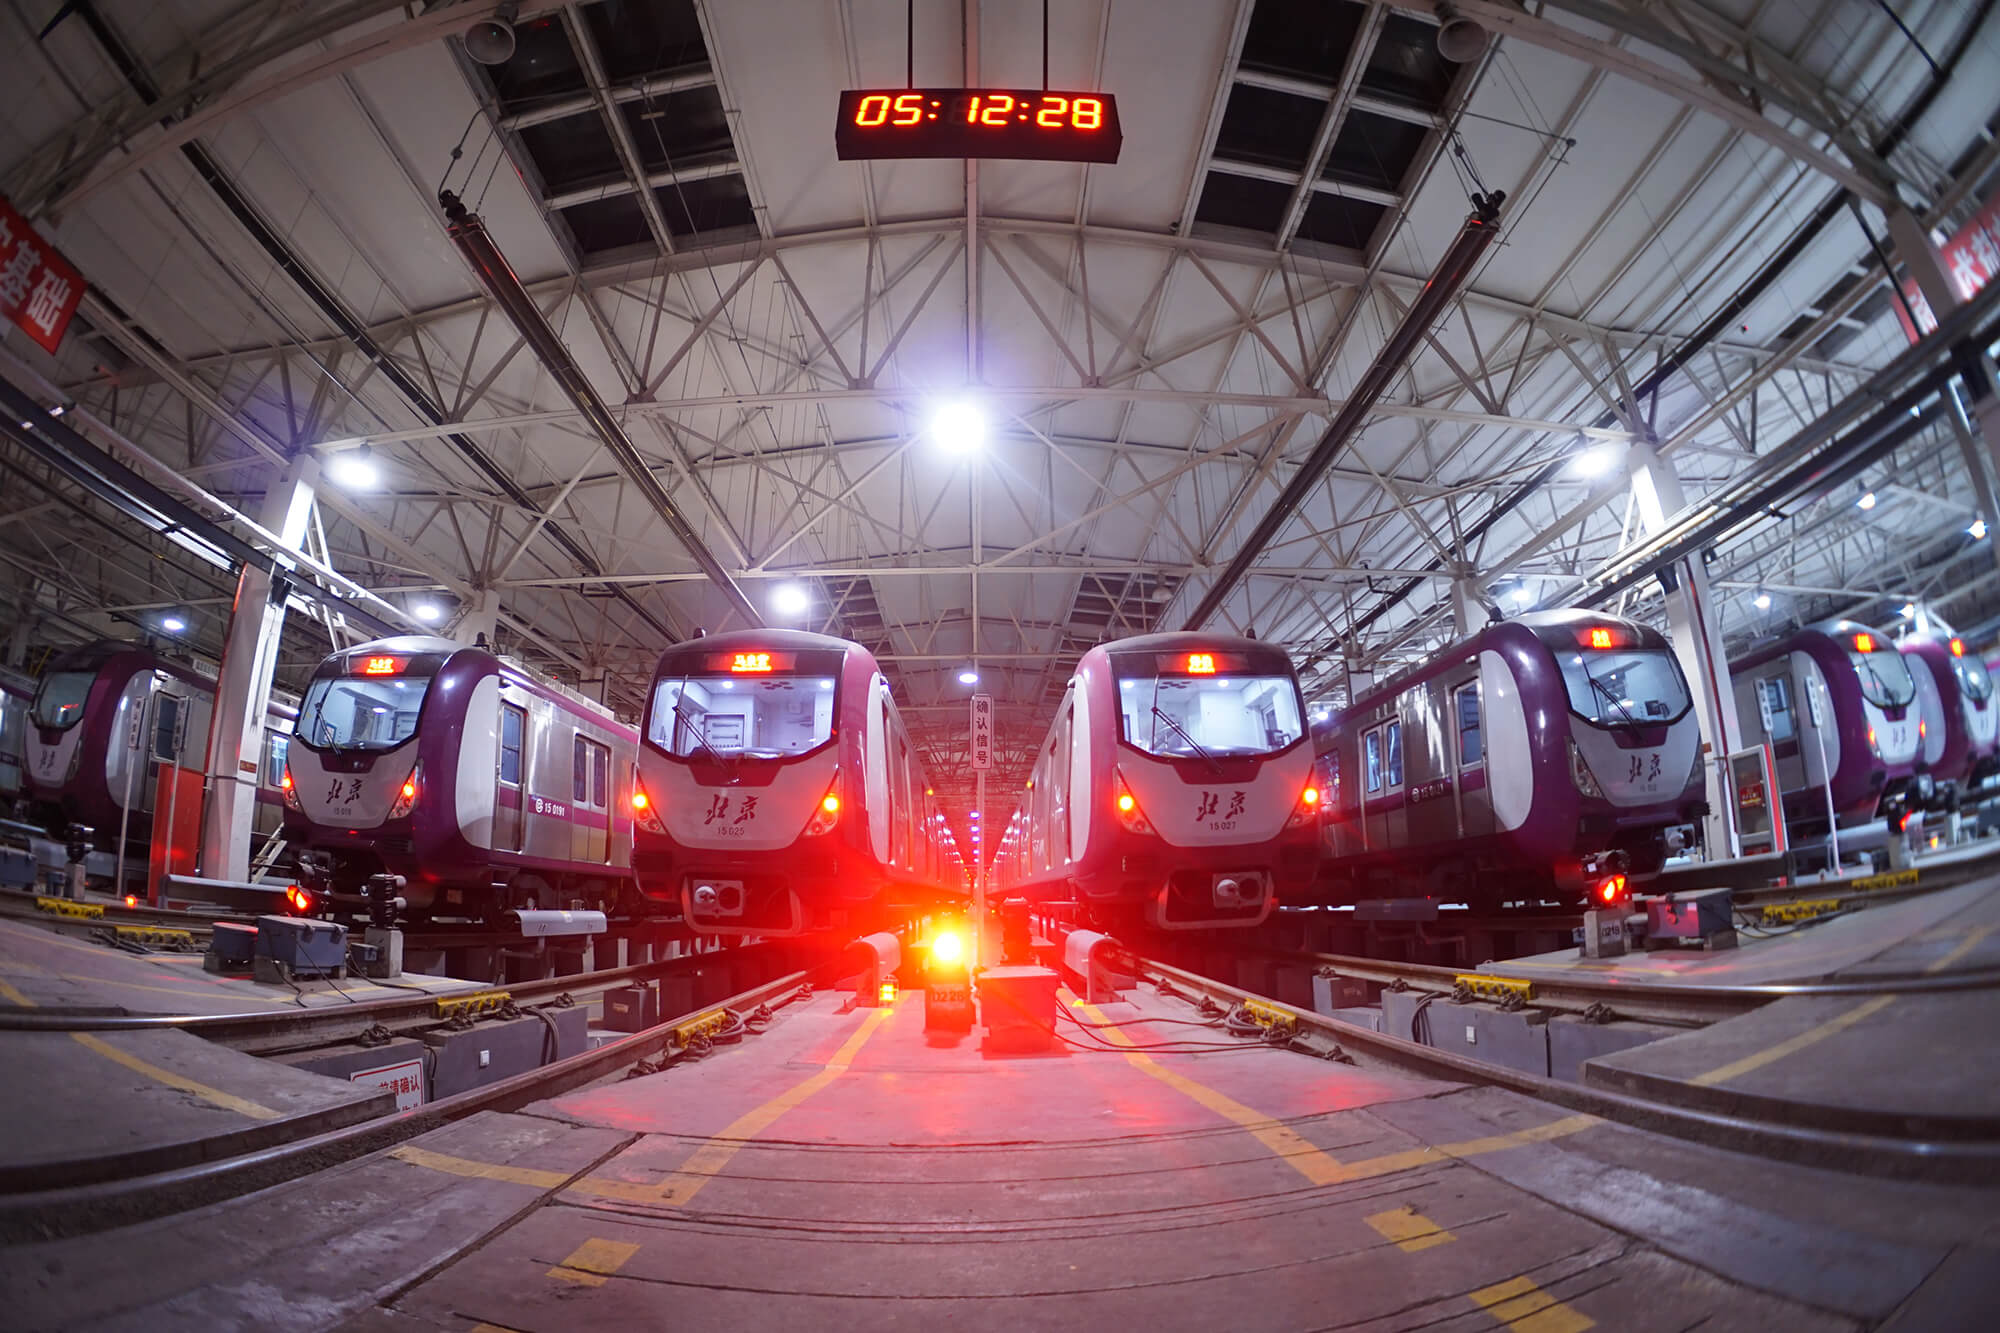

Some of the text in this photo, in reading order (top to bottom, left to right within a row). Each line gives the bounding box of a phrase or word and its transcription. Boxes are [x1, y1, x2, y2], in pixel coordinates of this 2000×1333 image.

[855, 94, 1102, 129] 05:12:28
[976, 700, 989, 764] 确认信号
[1628, 753, 1661, 783] 北京
[326, 778, 362, 804] 北京
[1195, 790, 1247, 822] 北京
[704, 793, 760, 825] 北京
